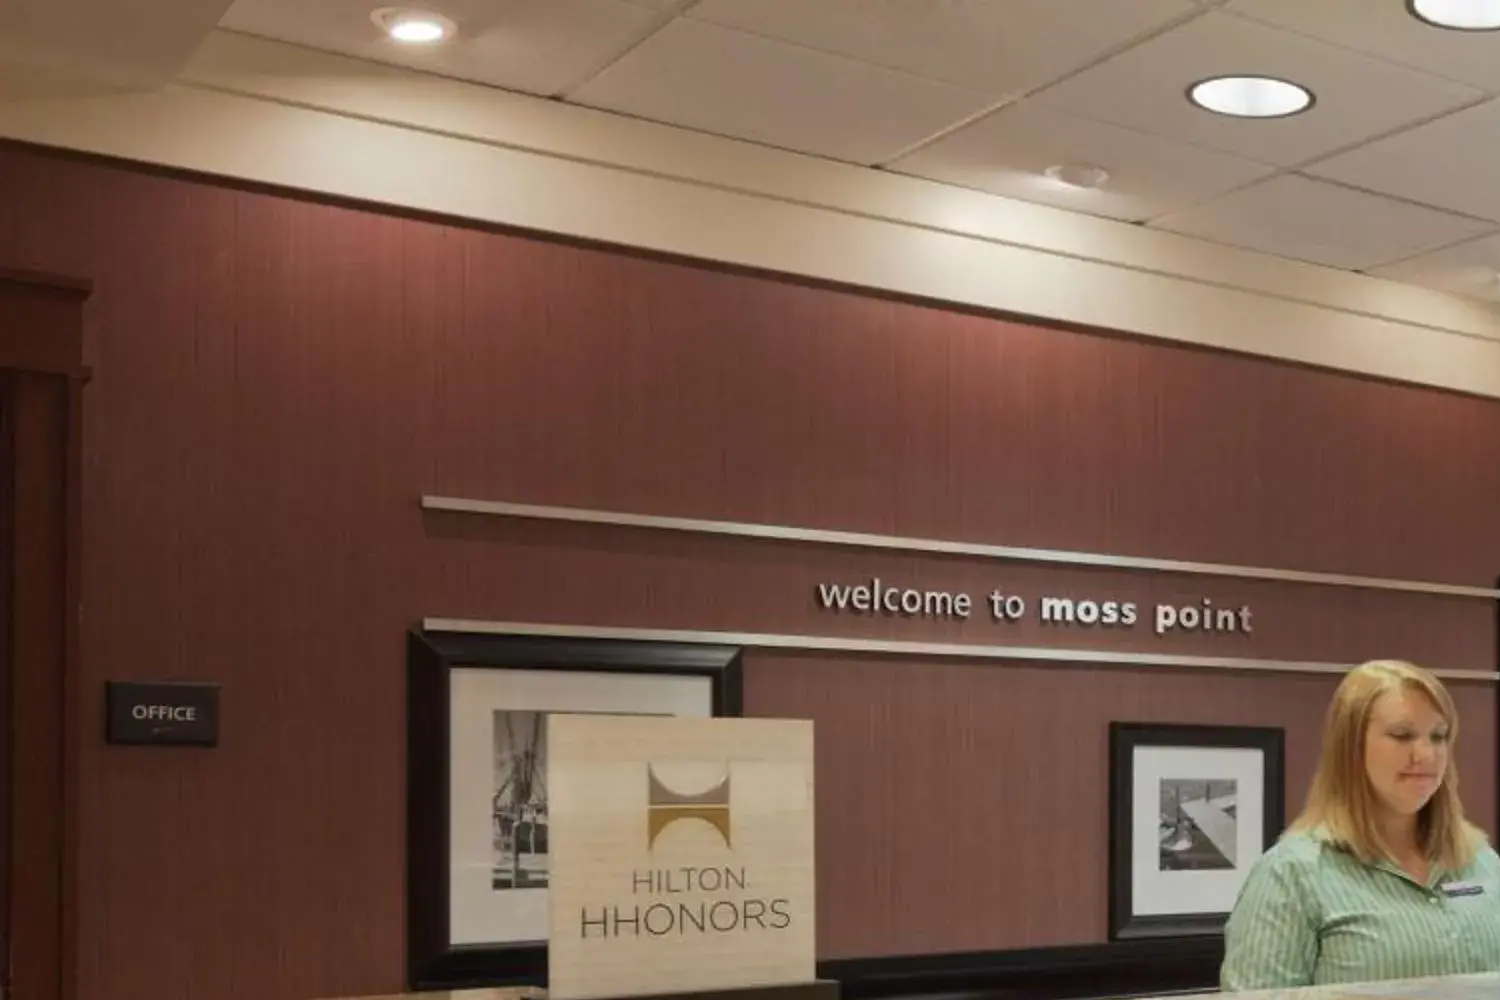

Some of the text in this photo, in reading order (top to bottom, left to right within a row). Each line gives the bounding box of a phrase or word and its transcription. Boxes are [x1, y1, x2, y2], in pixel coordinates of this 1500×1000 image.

[819, 577, 1253, 633] welcome to moss point
[131, 704, 197, 721] OFFICE
[632, 867, 746, 894] HILTON
[581, 899, 791, 938] HHONORS
